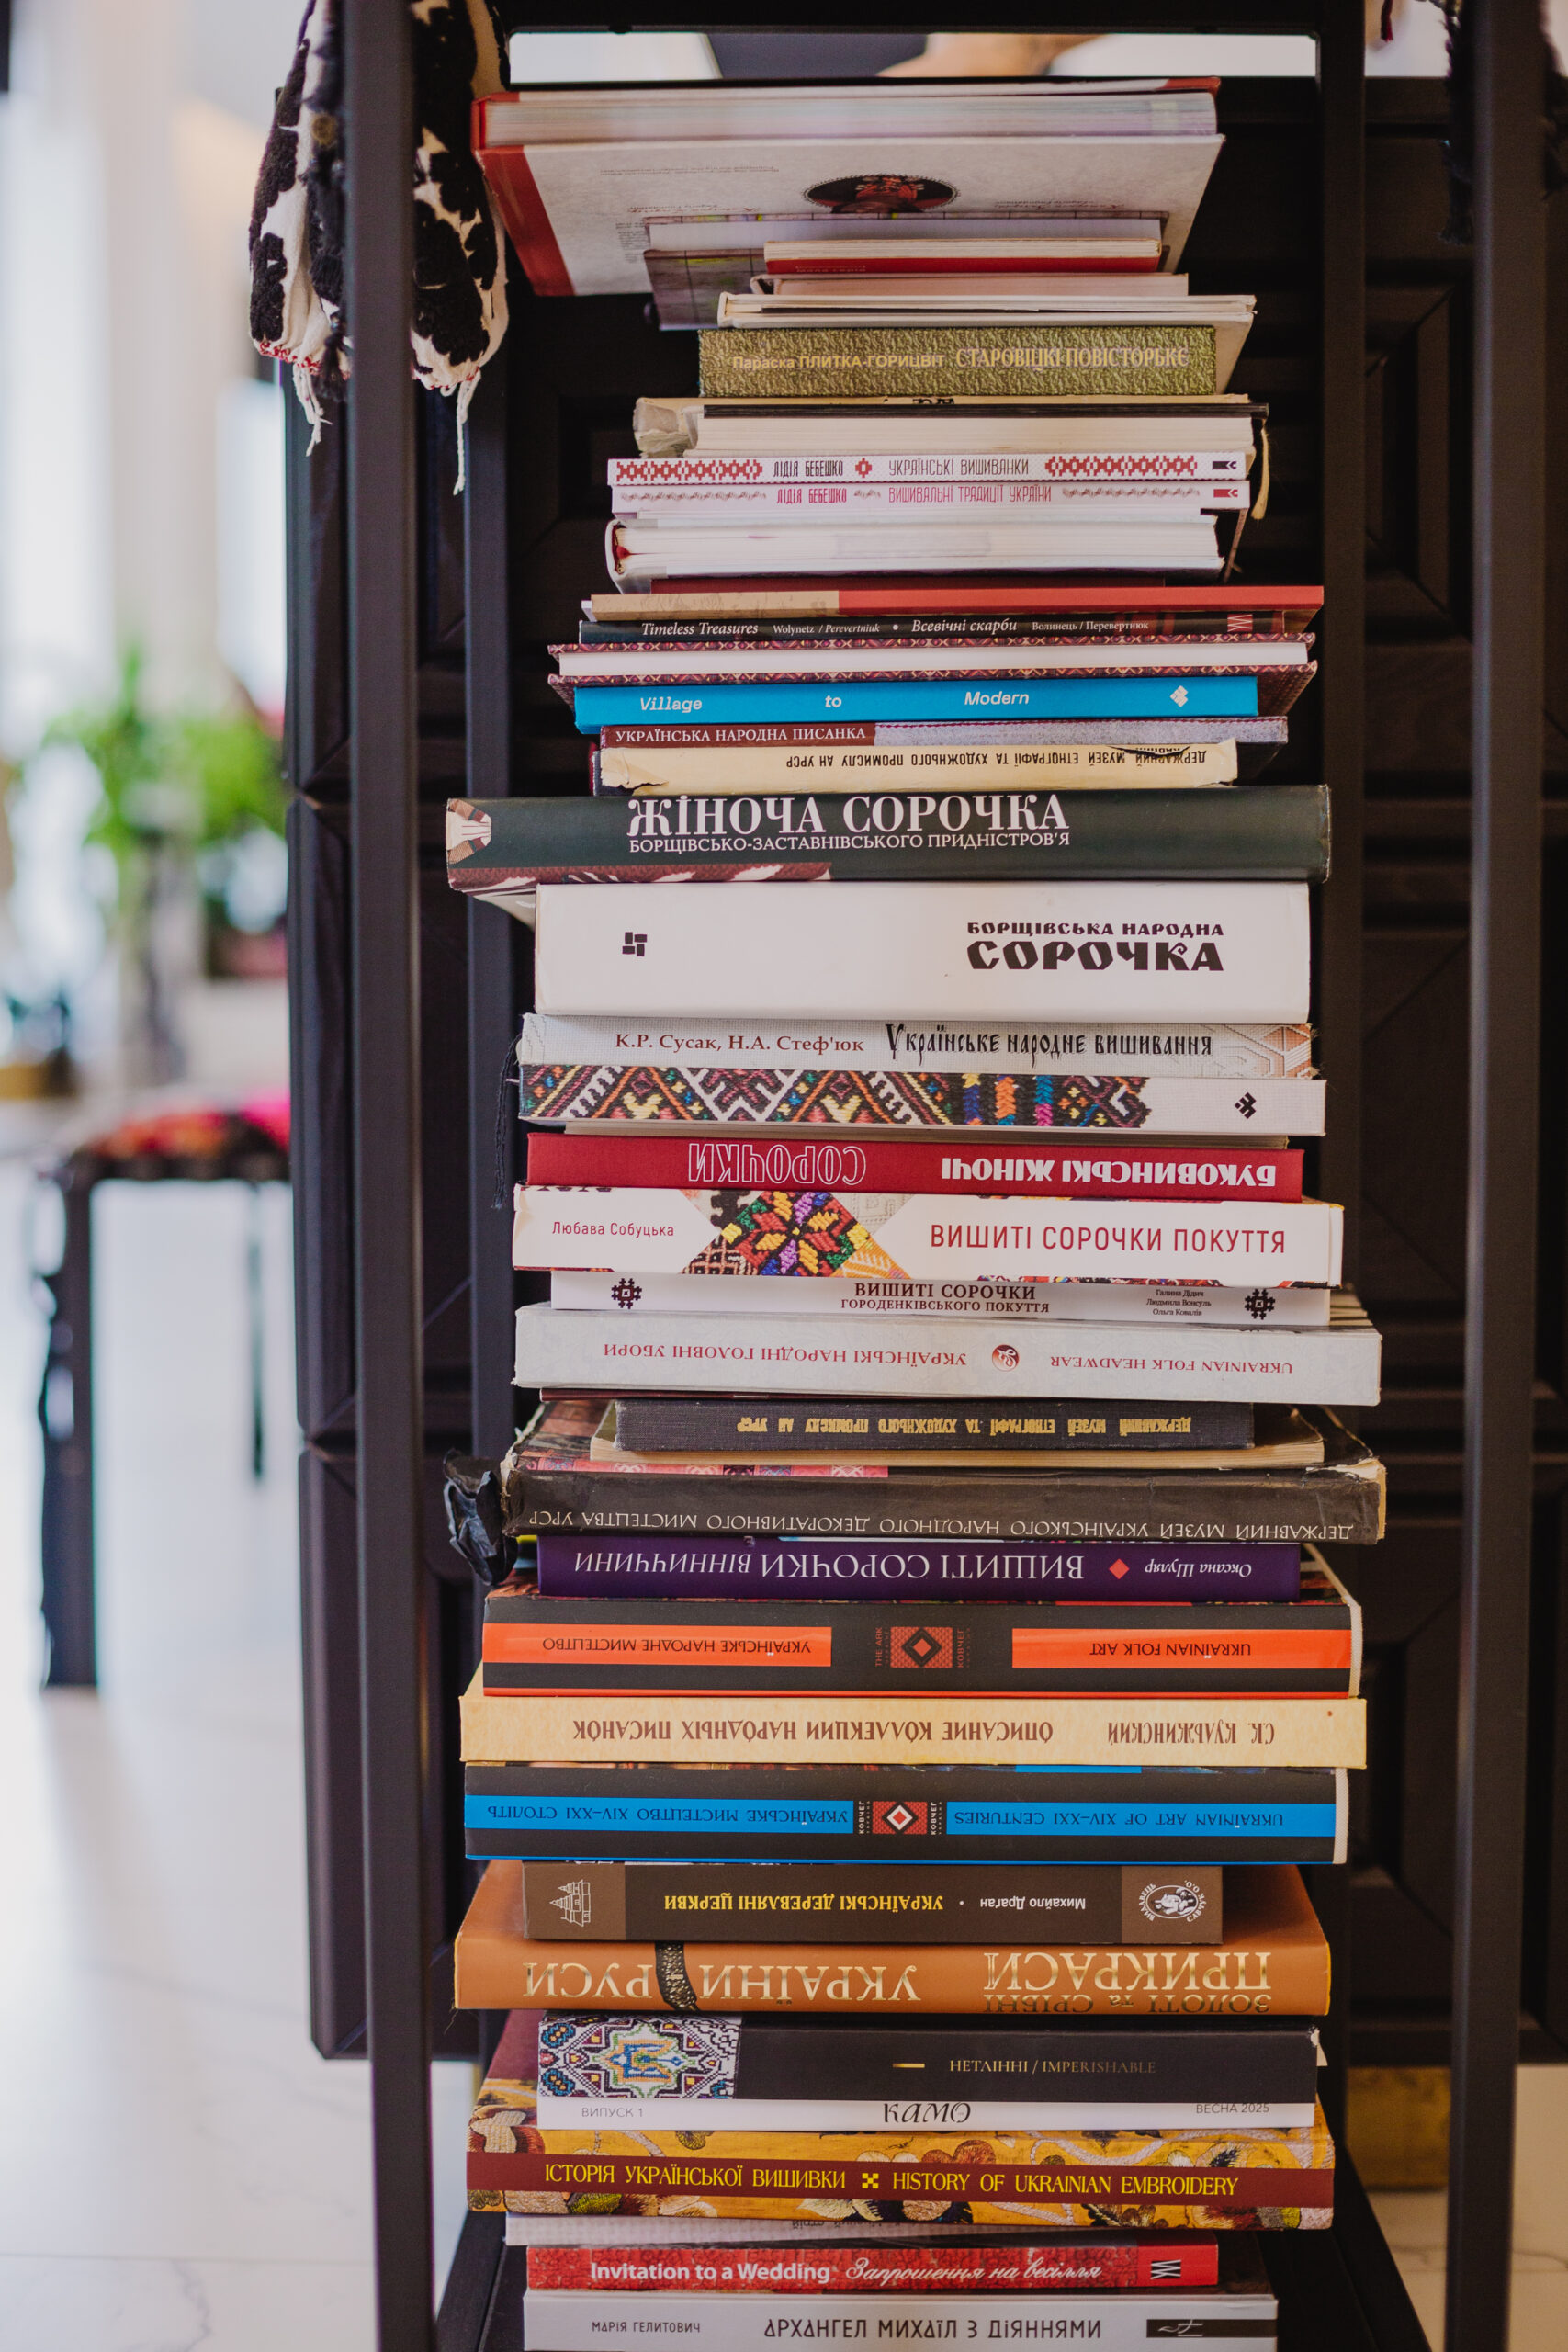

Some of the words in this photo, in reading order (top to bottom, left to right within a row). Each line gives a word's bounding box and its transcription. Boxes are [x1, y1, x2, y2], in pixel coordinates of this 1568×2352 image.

[732, 356, 795, 371] Параска
[799, 354, 944, 368] ПЛИТКА-ГОРИЦВІТ
[773, 459, 798, 478] ЛІДІЯ
[805, 459, 843, 478] БЕБЕШКО
[889, 457, 954, 476] УКРАЇНСЬКІ
[960, 458, 1029, 476] ВИШИВАНКИ
[776, 489, 802, 504] ЛІДІЯ
[808, 488, 847, 503] БЕБЕШКО
[888, 485, 953, 503] ВИШИВАЛЬНІ
[958, 483, 1004, 503] ТРАДИЦІЇ
[1009, 483, 1052, 503] УКРАЇНИ
[641, 621, 694, 636] Timeless
[698, 621, 759, 636] Treasures
[773, 623, 815, 636] Wolynetz
[825, 623, 880, 635] Perevertniuk
[911, 618, 966, 634] Всевічні
[970, 616, 1018, 634] скарби
[1032, 620, 1077, 632] Волинець
[1086, 619, 1149, 633] Перевертнюк
[640, 696, 703, 713] Village
[825, 695, 842, 708] to
[964, 691, 1030, 706] Modern
[615, 729, 711, 743] УКРАЇНСЬКА
[716, 729, 788, 742] НАРОДНА
[793, 727, 866, 741] ПИСАНКА
[785, 755, 815, 768] УРСР
[819, 754, 833, 767] АН
[841, 754, 904, 767] ПРОМИСЛУ
[911, 752, 987, 766] ХУДОЖНЬОГО
[996, 752, 1009, 764] ТА
[1014, 752, 1078, 768] ЕТНОГРАФІЇ
[1088, 752, 1125, 767] МУЗЕЙ
[627, 795, 826, 837] ЖІНОЧА
[842, 794, 1070, 834] СОРОЧКА
[629, 834, 923, 854] БОРЩІВСЬКО-ЗАСТАВНІВСЬКОГО
[928, 832, 1070, 850] ПРИДНІСТРОВ'Я
[967, 922, 1114, 937] БОРЩІВСЬКА
[1122, 922, 1224, 938] НАРОДНА
[966, 940, 1224, 971] СОРОЧКА
[615, 1034, 653, 1048] К.Р.
[659, 1034, 722, 1054] Сусак,
[728, 1035, 770, 1050] Н.А.
[776, 1035, 865, 1056] Стеф'юк
[688, 1143, 867, 1186] СОРОЧКИ
[942, 1157, 1055, 1182] ЖІНОЧІ
[1063, 1160, 1276, 1187] БУКОВИНСЬКІ
[552, 1221, 605, 1235] Любава
[610, 1222, 674, 1239] Собуцька
[931, 1224, 1031, 1249] ВИШИТІ
[1043, 1226, 1161, 1251] СОРОЧКИ
[1174, 1228, 1285, 1253] ПОКУТТЯ
[854, 1282, 933, 1298] ВИШИТІ
[941, 1283, 1036, 1300] СОРОЧКИ
[840, 1298, 981, 1312] ГОРОДЕНКІВСЬКОГО
[986, 1301, 1049, 1313] ПОКУТТЯ
[604, 1343, 666, 1359] УБОРИ
[672, 1345, 754, 1361] ГОЛОВНІ
[761, 1346, 847, 1363] НАРОДНІ
[853, 1349, 967, 1366] УКРАЇНСЬКІ
[1050, 1356, 1145, 1370] HEADWEAR
[1152, 1359, 1195, 1372] FOLK
[1201, 1360, 1292, 1374] UKRAINIAN
[965, 1419, 980, 1433] ТА
[528, 1510, 573, 1525] УРСР
[581, 1510, 697, 1528] МИСТЕЦТВА
[706, 1514, 870, 1532] ДЕКОРАТИВНОГО
[879, 1518, 999, 1534] НАРОДНОГО
[1010, 1521, 1149, 1537] УКРАЇНСЬКОГО
[1159, 1522, 1224, 1540] МУЗЕЙ
[1236, 1523, 1354, 1541] ДЕРЖАВНИЙ
[573, 1551, 752, 1574] ВІННИЧЧИНИ
[761, 1553, 931, 1579] СОРОЧКИ
[940, 1554, 1084, 1580] ВИШИТІ
[1145, 1559, 1194, 1577] Шуляр
[1199, 1562, 1252, 1577] Оксана
[542, 1636, 637, 1652] МИСТЕЦТВО
[640, 1638, 716, 1653] НАРОДНЕ
[720, 1639, 811, 1657] УКРАЇНСЬКЕ
[1089, 1643, 1118, 1657] ART
[1122, 1642, 1161, 1657] FOLK
[572, 1719, 671, 1743] ПИСАНОК
[681, 1719, 796, 1743] НАРОДНЫХ
[806, 1719, 932, 1743] КОЛЛЕКЦИИ
[942, 1720, 1054, 1744] ОПИСАНИЕ
[1108, 1718, 1236, 1746] КУЛЬЖИНСКИЙ
[487, 1804, 558, 1819] СТОЛІТЬ
[637, 1806, 738, 1822] МИСТЕЦТВО
[747, 1809, 848, 1826] УКРАЇНСЬКЕ
[953, 1811, 1045, 1825] CENTURIES
[1124, 1812, 1147, 1826] OF
[1155, 1812, 1187, 1826] ART
[663, 1892, 733, 1911] ЦЕРКВИ
[738, 1893, 835, 1911] ДЕРЕВЛЯНІ
[840, 1894, 943, 1915] УКРАЇНСЬКІ
[979, 1895, 1025, 1911] Драґан
[1029, 1897, 1086, 1910] Михайло
[983, 1951, 1272, 1991] ПРИКРАСИ
[522, 1962, 653, 1999] РУСИ
[698, 1963, 922, 2006] УКРАЇНИ
[983, 1994, 1094, 2014] СРІБНІ
[1108, 1994, 1134, 2008] та
[1148, 1994, 1272, 2014] ЗОЛОТІ
[950, 2059, 1028, 2074] НЕТЛІННІ
[1043, 2059, 1156, 2075] IMPERISHABLE
[581, 2106, 635, 2119] ВИПУСК
[1196, 2102, 1238, 2115] ВЕСНА
[1241, 2101, 1270, 2114] 2025
[545, 2162, 615, 2184] ІСТОРІЯ
[625, 2163, 743, 2187] УКРАЇНСЬКОЇ
[752, 2168, 847, 2189] ВИШИВКИ
[893, 2171, 970, 2192] HISTORY
[980, 2173, 1006, 2192] OF
[1014, 2174, 1111, 2195] UKRAINIAN
[1121, 2176, 1238, 2196] EMBROIDERY
[591, 2262, 690, 2280] Invitation
[695, 2264, 717, 2280] to
[721, 2267, 734, 2280] a
[737, 2262, 830, 2285] Wedding
[845, 2256, 986, 2287] Запрошення
[987, 2265, 1022, 2281] на
[1023, 2256, 1102, 2281] весілля
[633, 2321, 701, 2335] ГЕЛИТОВИЧ
[763, 2318, 867, 2339] АРХАНГЕЛ
[878, 2318, 957, 2339] МИХАЇЛ
[966, 2319, 978, 2339] З
